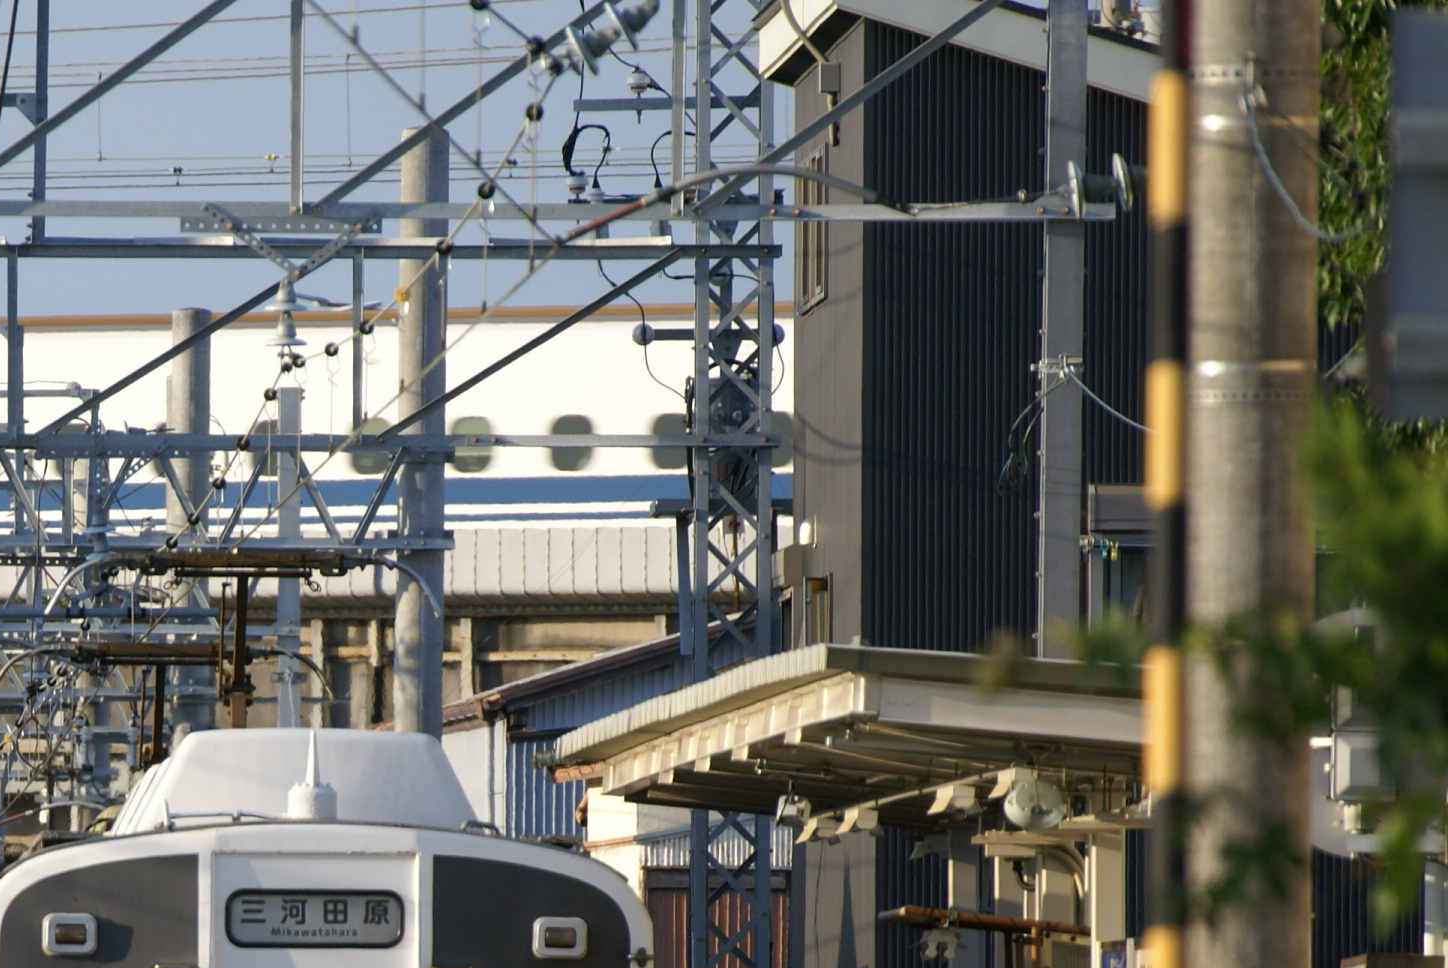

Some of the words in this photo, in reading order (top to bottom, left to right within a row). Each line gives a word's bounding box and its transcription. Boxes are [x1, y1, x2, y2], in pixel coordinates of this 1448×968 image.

[240, 898, 391, 925] 三河田原
[270, 926, 359, 938] Mikawatahara
